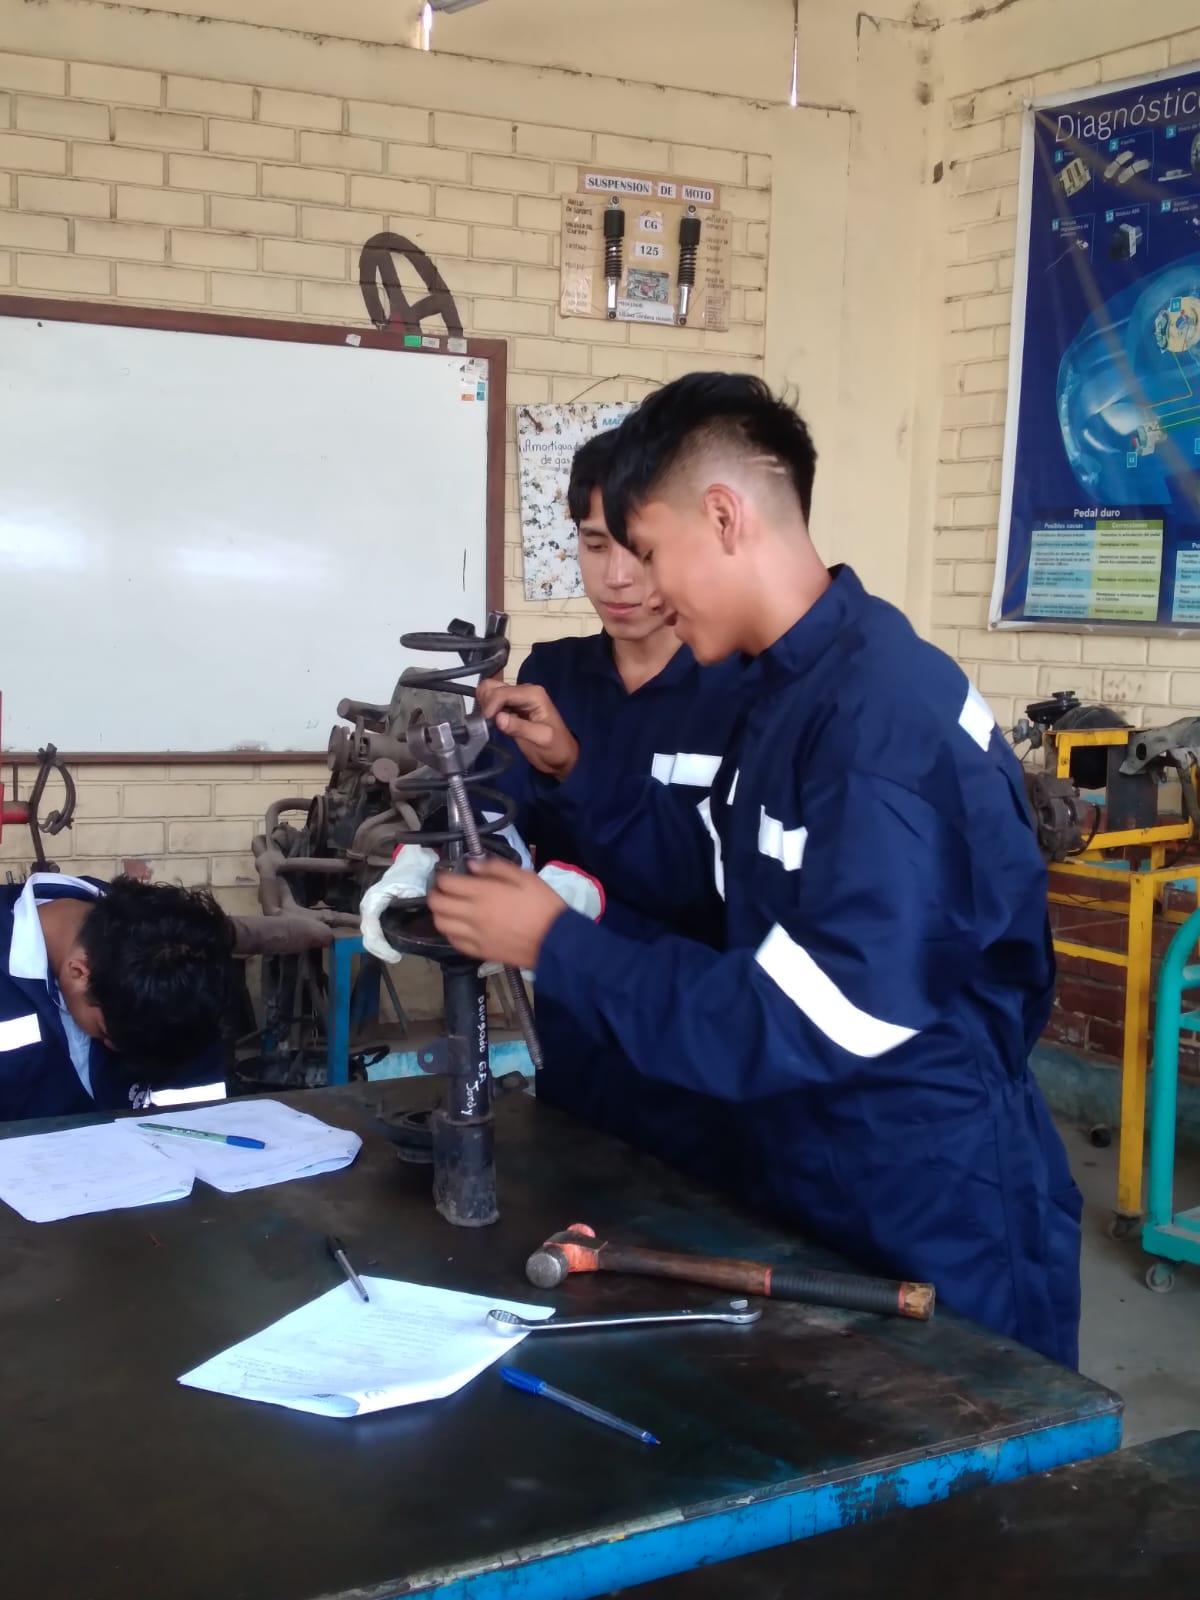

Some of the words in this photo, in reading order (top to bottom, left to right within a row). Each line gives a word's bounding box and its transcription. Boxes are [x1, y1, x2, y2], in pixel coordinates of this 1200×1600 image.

[1055, 86, 1200, 142] Diagnóstic
[588, 176, 650, 194] SUSPENSION
[660, 185, 673, 197] DE
[684, 188, 712, 201] MOTO
[644, 219, 658, 230] CG
[639, 245, 659, 257] 125
[523, 438, 582, 456] Amortiguad
[541, 455, 553, 466] de
[555, 458, 571, 470] gas
[1074, 507, 1098, 518] Pedal
[1100, 507, 1121, 518] duro
